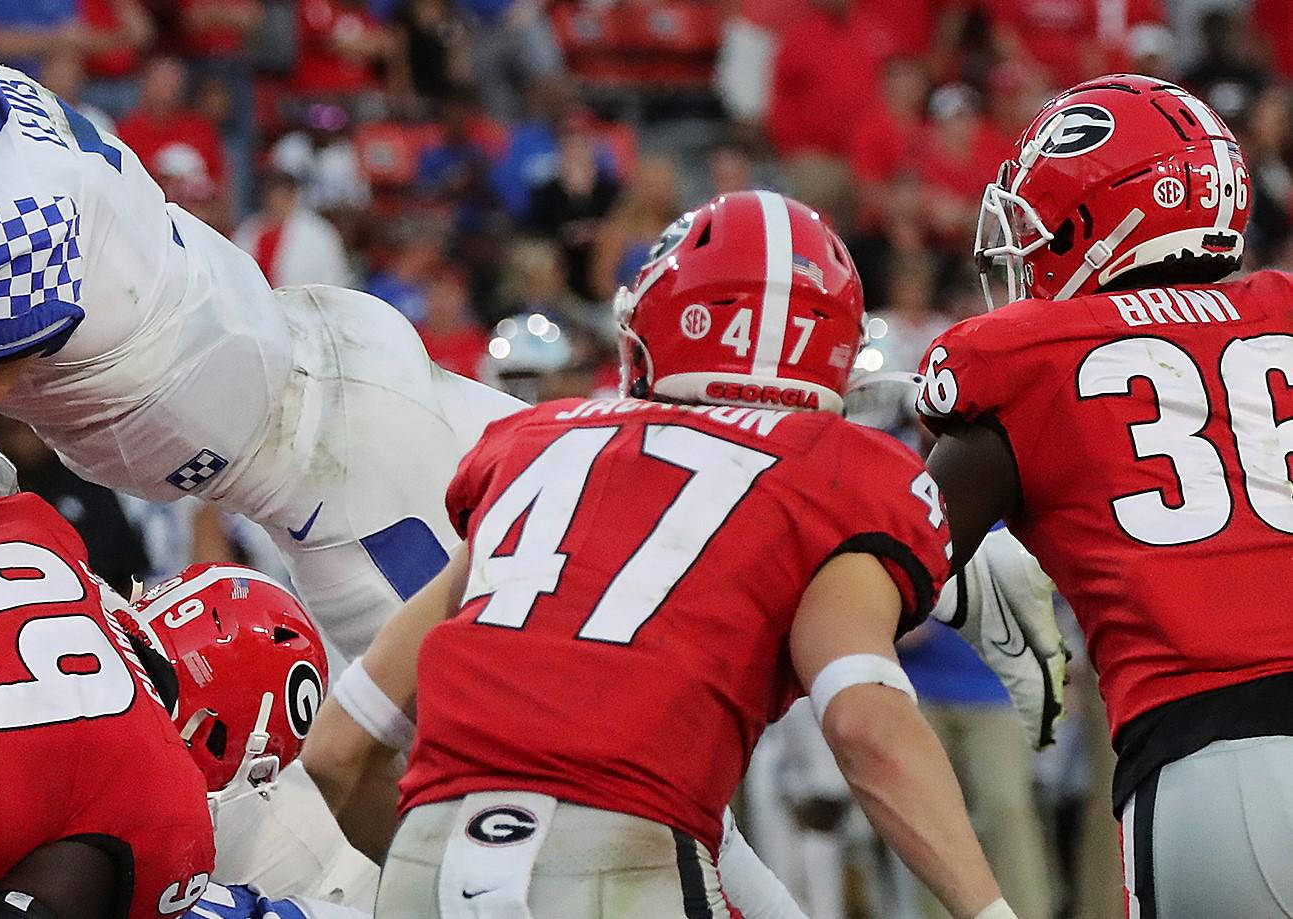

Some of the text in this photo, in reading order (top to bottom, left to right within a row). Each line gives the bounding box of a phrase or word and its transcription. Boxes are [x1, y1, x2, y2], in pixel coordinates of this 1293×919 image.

[1156, 181, 1185, 206] SEC
[1109, 287, 1241, 327] BRINI
[682, 309, 710, 337] SEC
[706, 380, 820, 410] GEORGIA
[461, 423, 782, 645] 47
